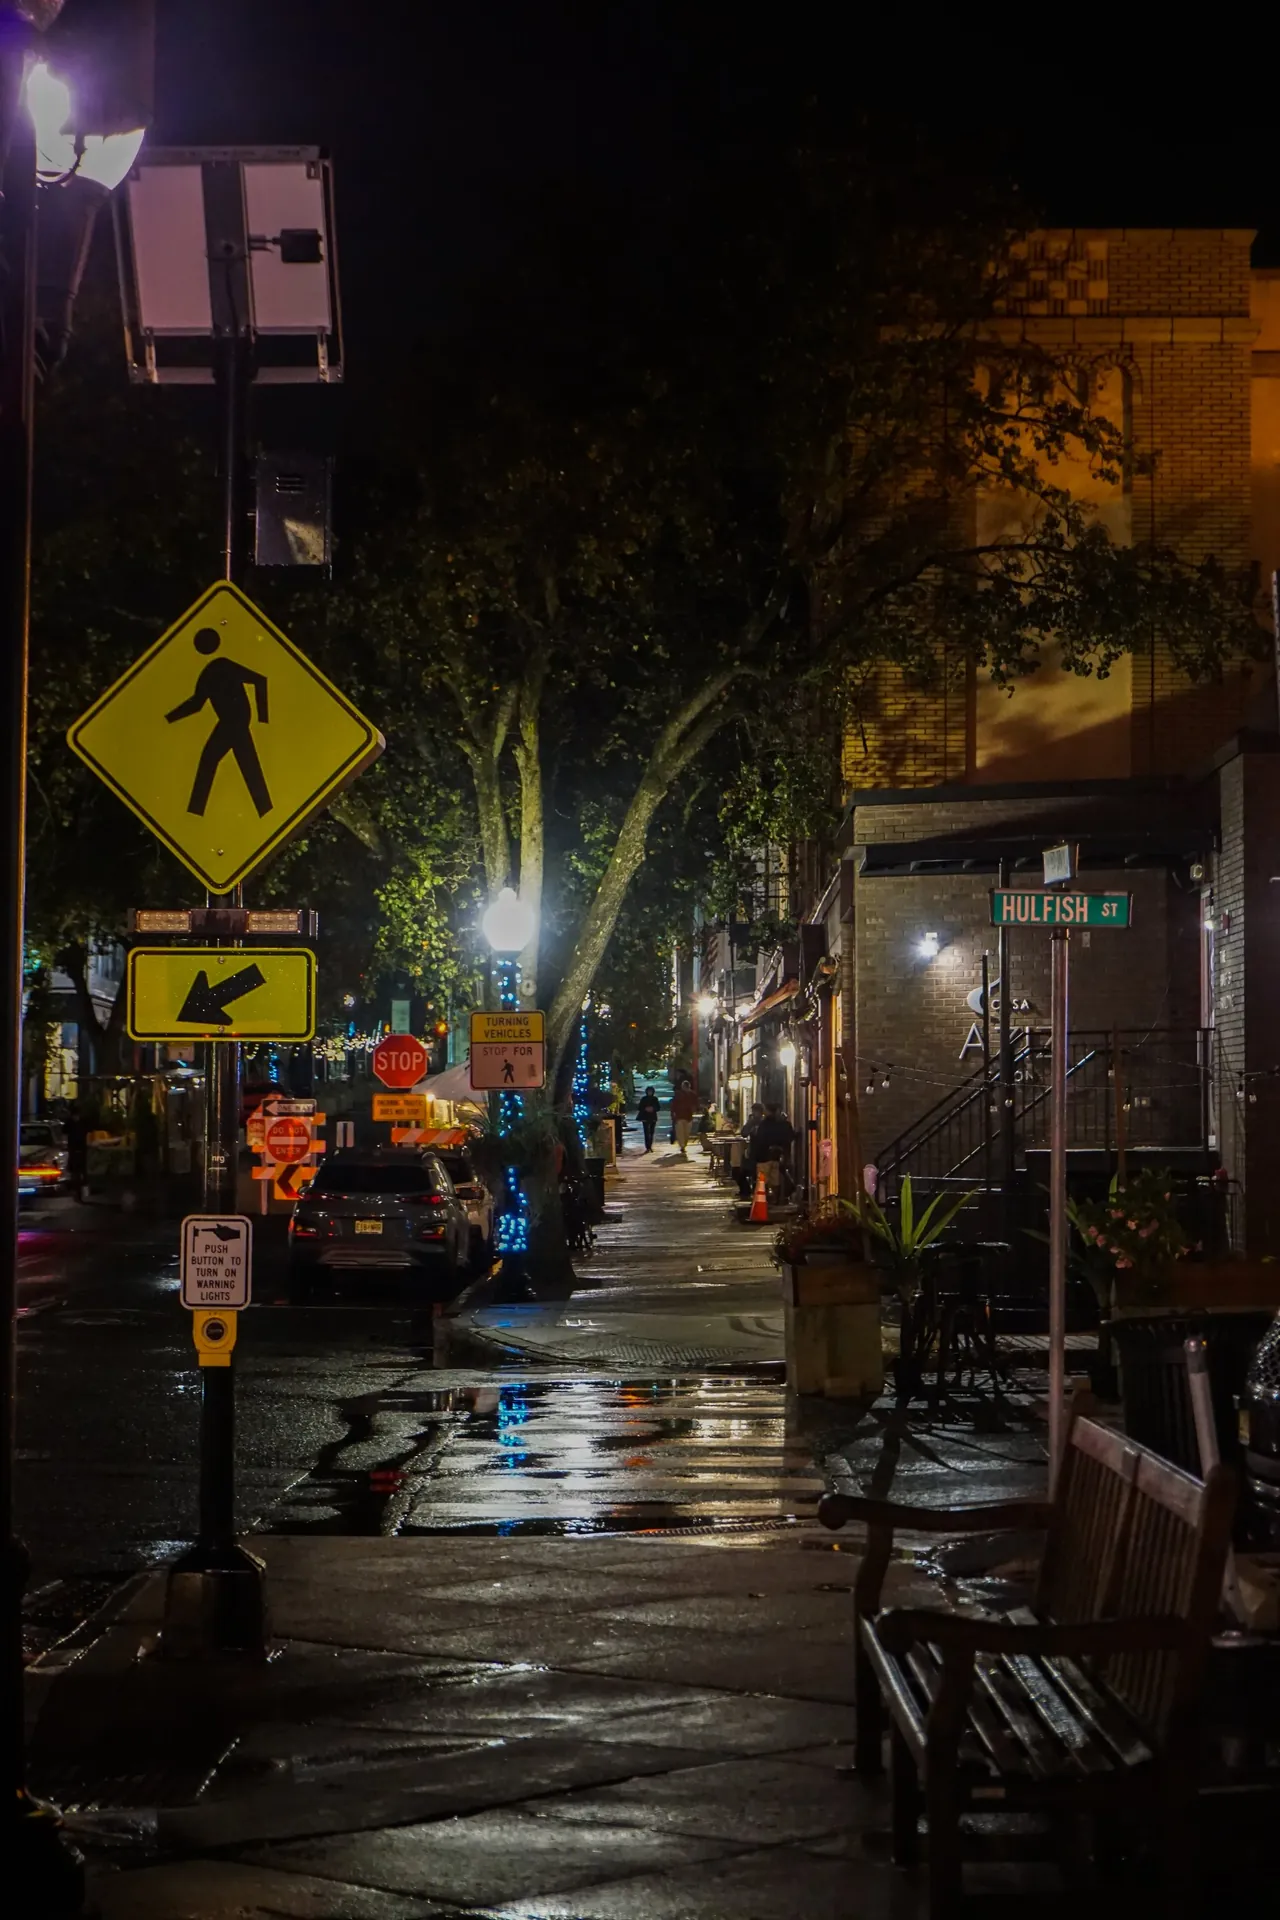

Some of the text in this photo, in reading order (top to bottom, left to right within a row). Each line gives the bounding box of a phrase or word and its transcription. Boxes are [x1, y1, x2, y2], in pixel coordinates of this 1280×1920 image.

[1002, 895, 1118, 923] HULFISH ST
[991, 998, 1030, 1010] CSA
[486, 1017, 529, 1027] TURNING
[483, 1029, 532, 1038] VEHICLES
[483, 1046, 533, 1056] STOP FOR
[377, 1051, 424, 1071] STOP
[278, 1104, 314, 1112] ONE WAY
[275, 1147, 301, 1155] ENTER
[204, 1244, 228, 1254] PUSH
[191, 1256, 241, 1266] BUTTON TO
[196, 1267, 237, 1277] TURN ON
[196, 1279, 235, 1289] WARNING
[200, 1291, 230, 1301] LIGHTS
